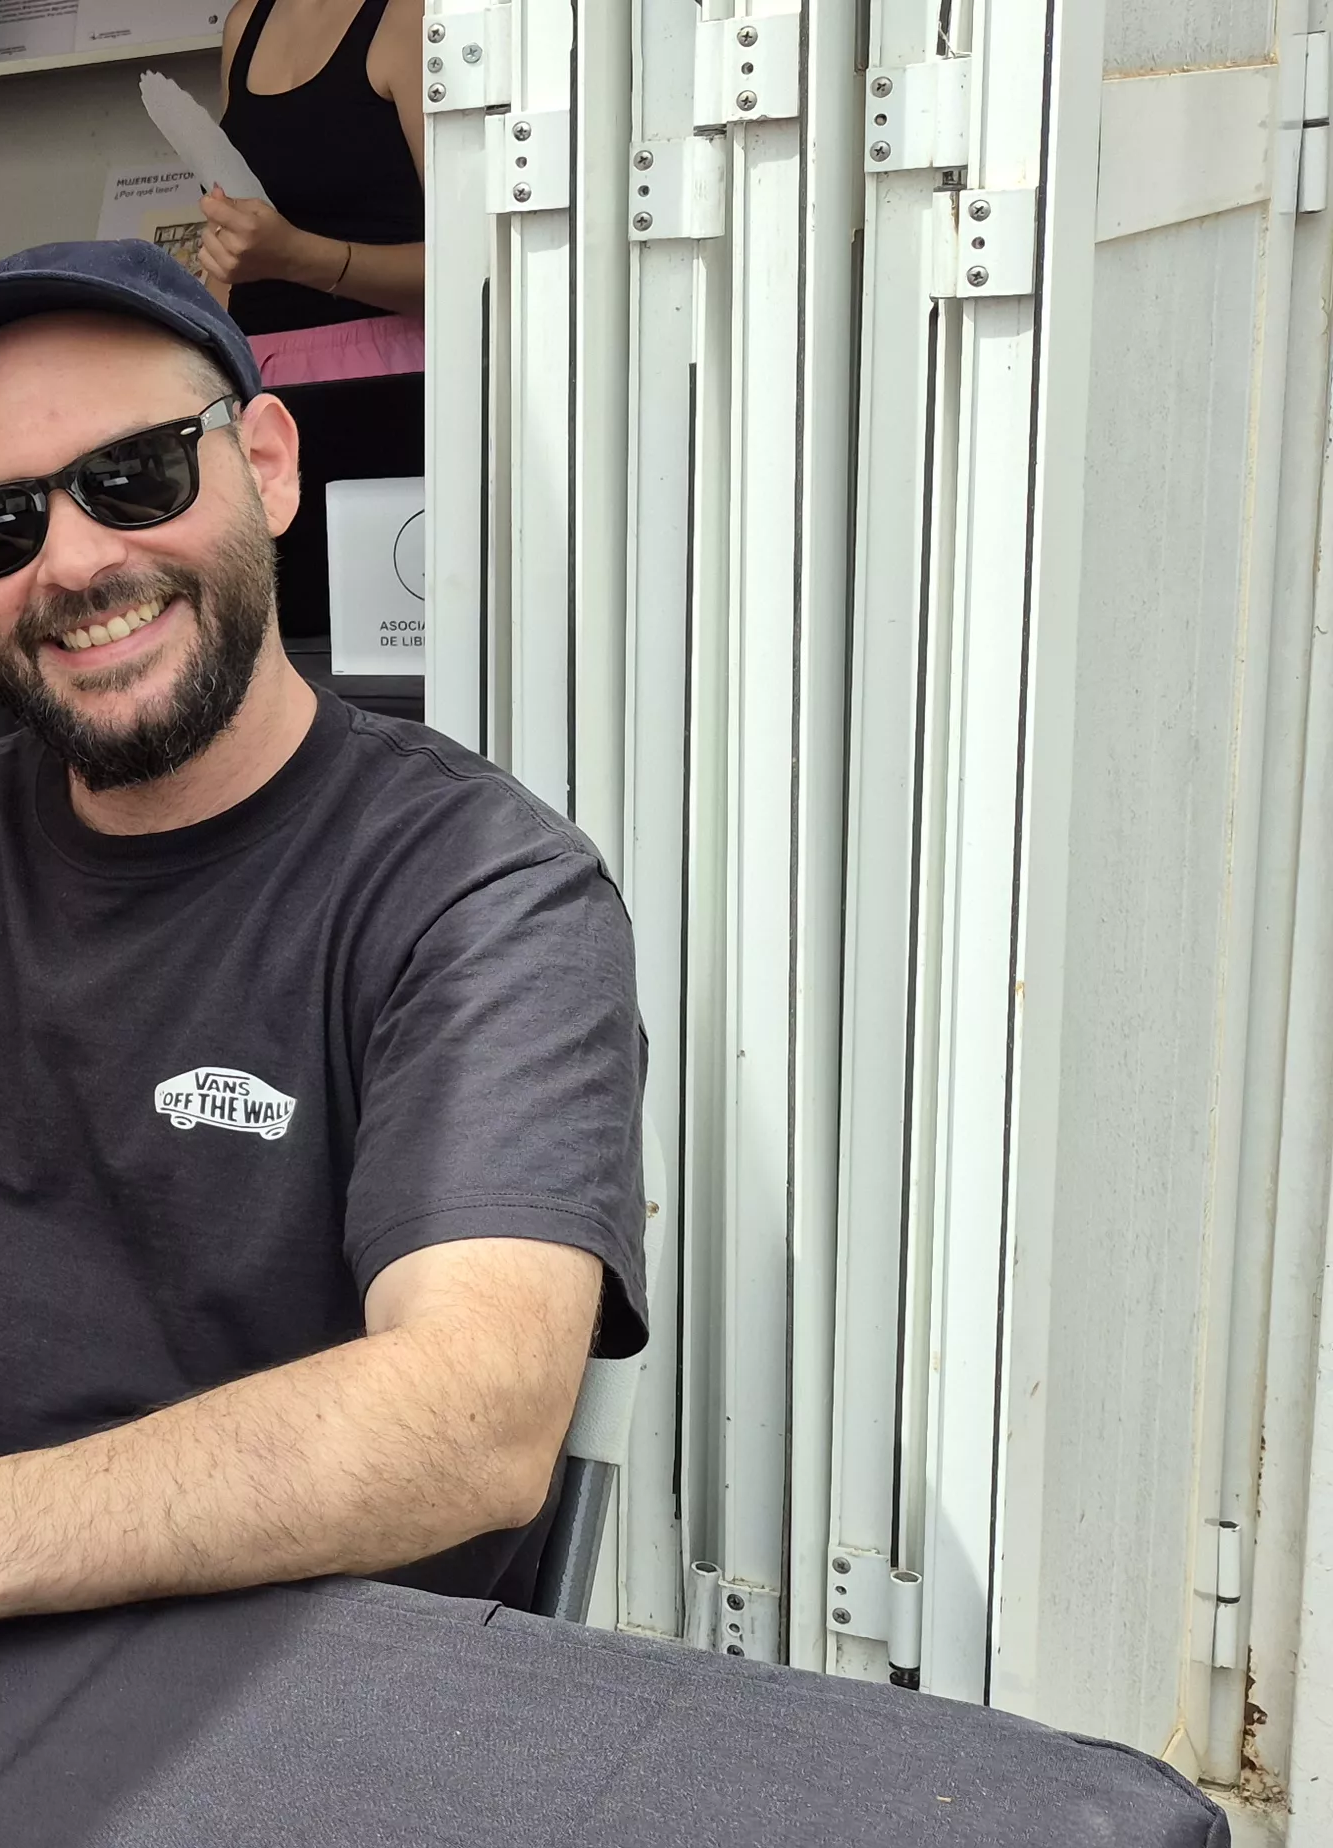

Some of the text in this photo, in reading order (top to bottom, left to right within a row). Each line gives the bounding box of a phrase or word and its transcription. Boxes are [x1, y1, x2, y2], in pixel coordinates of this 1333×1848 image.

[116, 174, 159, 187] MUJERES
[114, 184, 180, 200] ¿Por qué leer?
[380, 636, 398, 647] DE
[194, 1071, 251, 1097] VANS
[198, 1092, 239, 1123] THE
